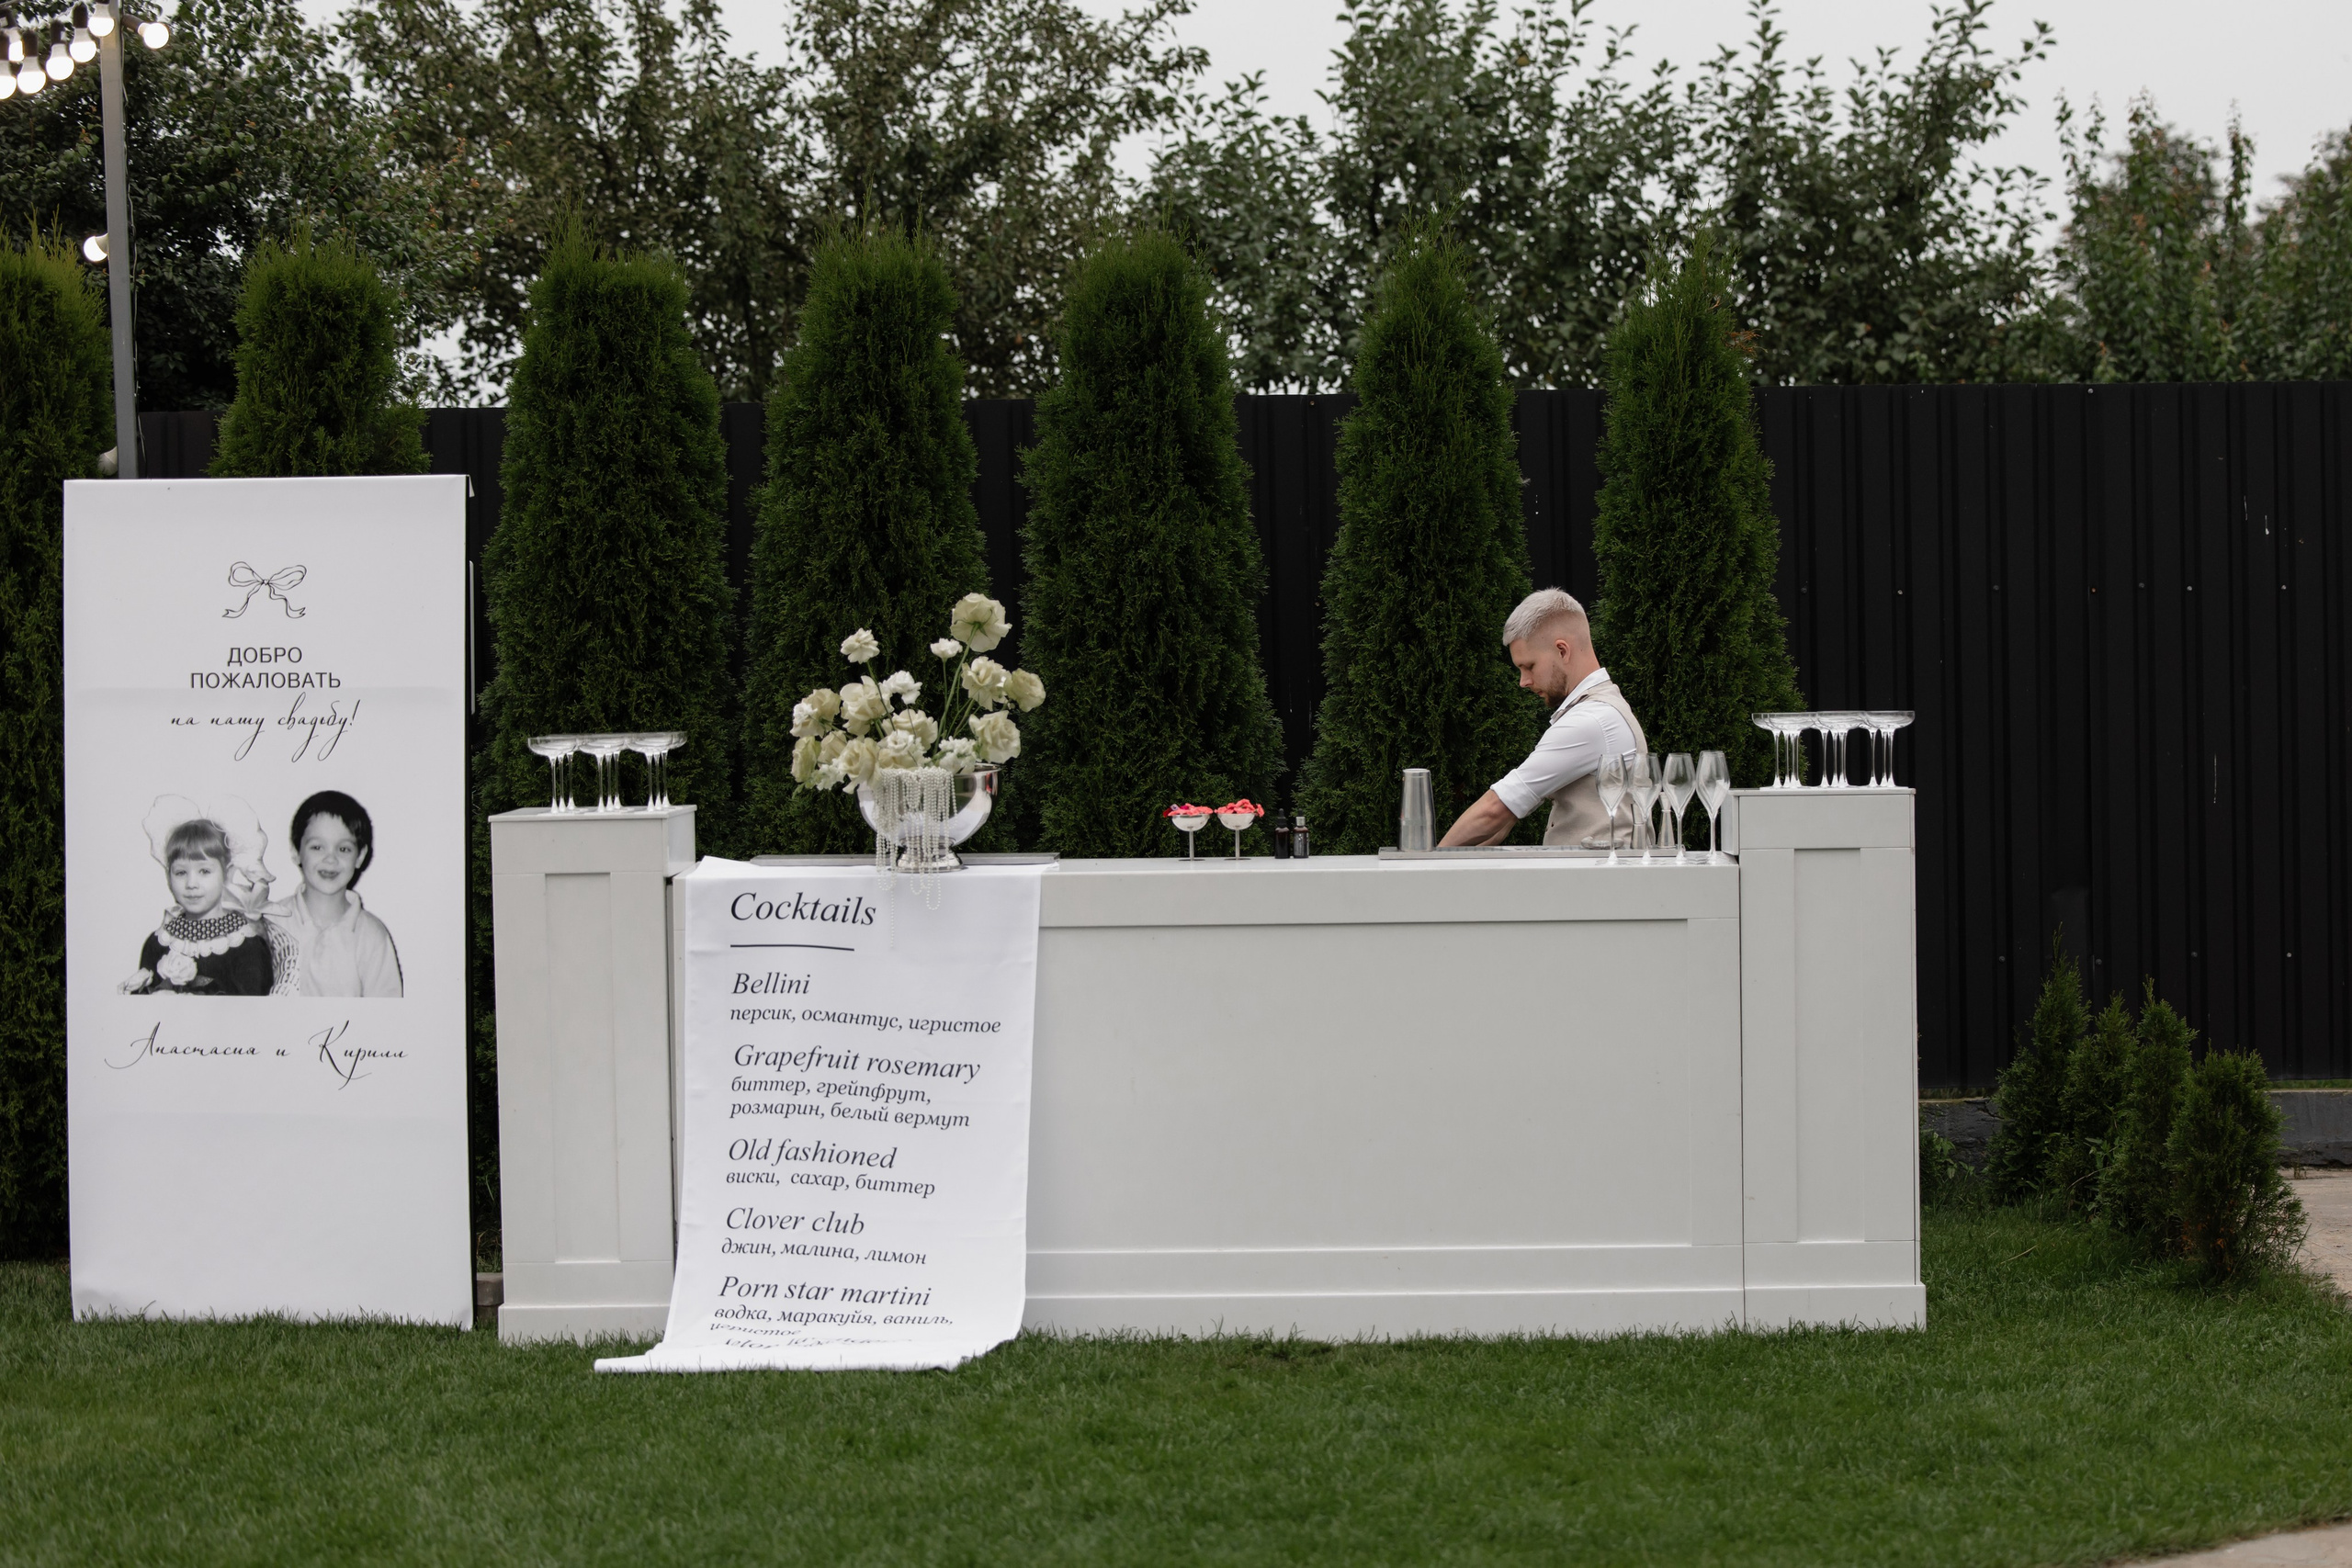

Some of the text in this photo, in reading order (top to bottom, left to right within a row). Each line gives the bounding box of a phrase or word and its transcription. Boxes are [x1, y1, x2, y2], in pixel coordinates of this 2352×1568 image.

[227, 646, 302, 667] ДОБРО
[190, 671, 341, 689] ПОЖАЛОВАТЬ
[170, 691, 360, 762] на нашу свадьбу!
[730, 891, 876, 925] Cocktails
[730, 971, 810, 994] Bellini
[729, 1008, 1001, 1035] персик, османтус, игристое
[104, 1019, 407, 1090] Анастасия и Кирилл
[734, 1043, 980, 1084] Grapefruit rosemary
[730, 1075, 931, 1104] биттер, грейпфрут,
[729, 1100, 969, 1130] розмарин, белый вермут
[728, 1137, 898, 1168] Old fashioned
[725, 1171, 935, 1199] виски, сахар, биттер
[726, 1206, 865, 1235] Clover club
[720, 1236, 926, 1264] джин, малина, лимон
[717, 1275, 932, 1305] Porn star martini
[714, 1304, 953, 1325] водка, маракуйя, ваниль,
